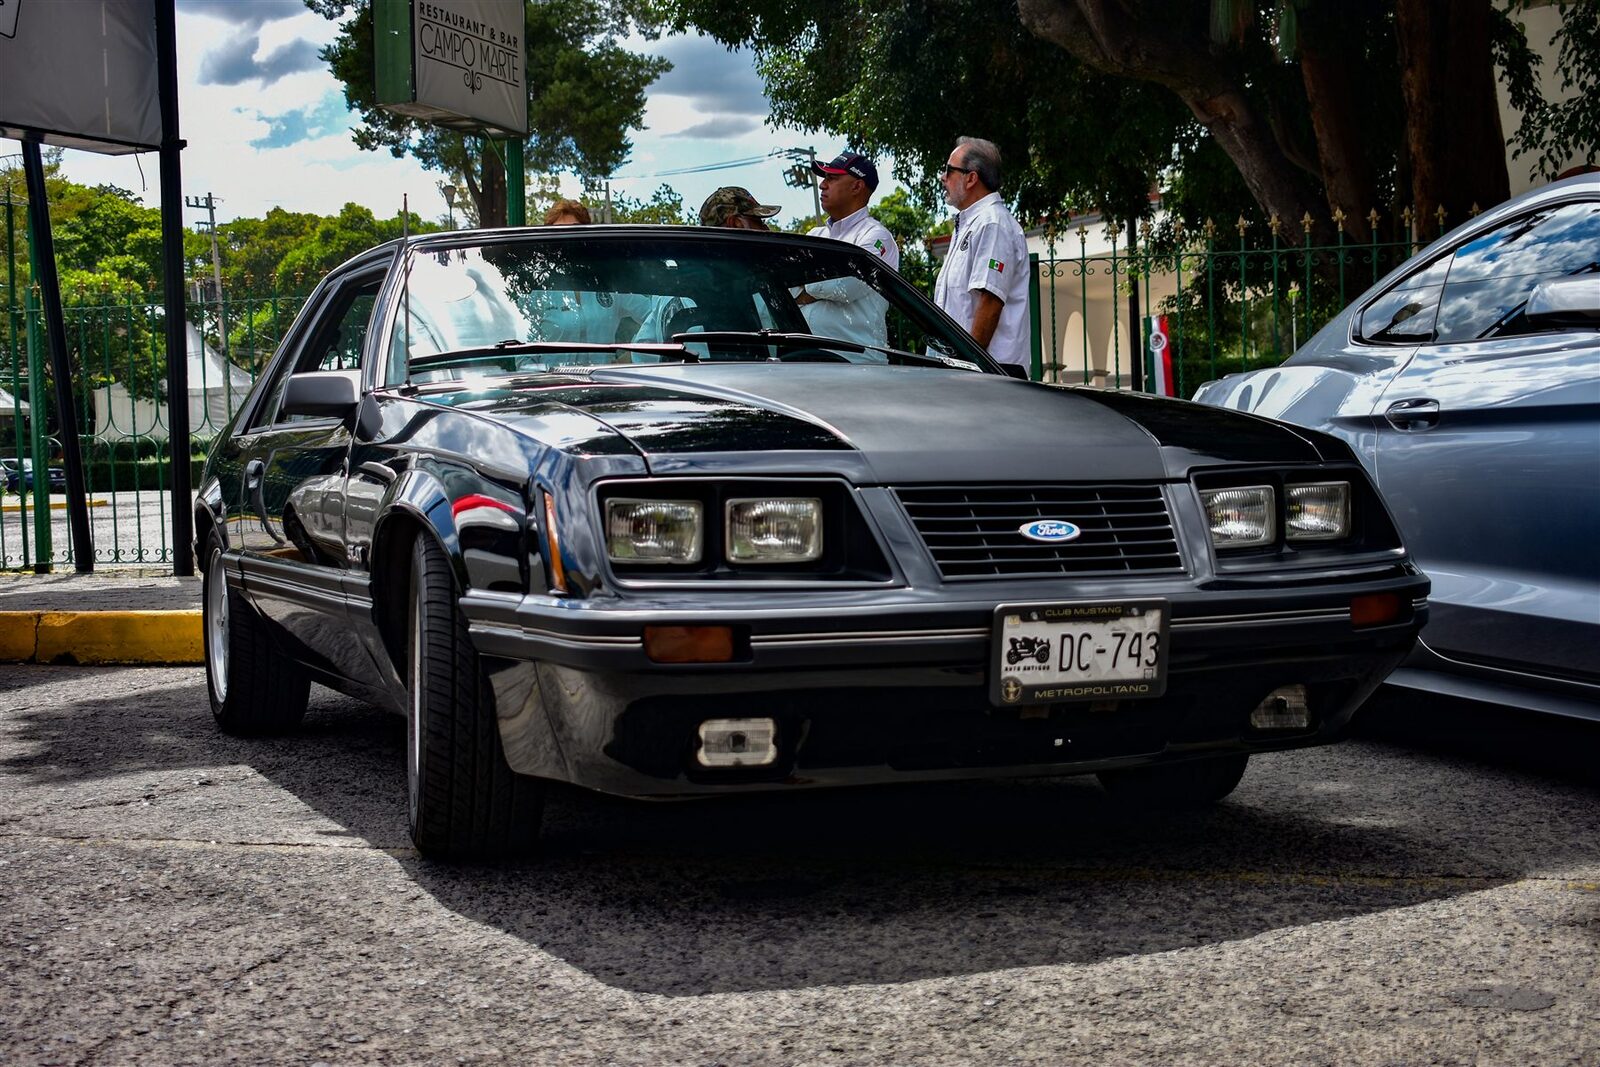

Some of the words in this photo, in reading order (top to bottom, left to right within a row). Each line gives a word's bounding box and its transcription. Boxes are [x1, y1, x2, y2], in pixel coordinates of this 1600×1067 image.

[420, 2, 486, 36] RESTAURANT
[490, 27, 496, 40] &
[500, 31, 518, 48] BAR
[420, 23, 476, 67] CAMPO
[479, 42, 520, 83] MARTE
[1037, 523, 1067, 536] Ford
[1045, 608, 1072, 616] CLUB
[1073, 606, 1122, 615] MUSTANG
[1058, 631, 1160, 672] DC-743
[1034, 684, 1149, 699] METROPOLITANO
